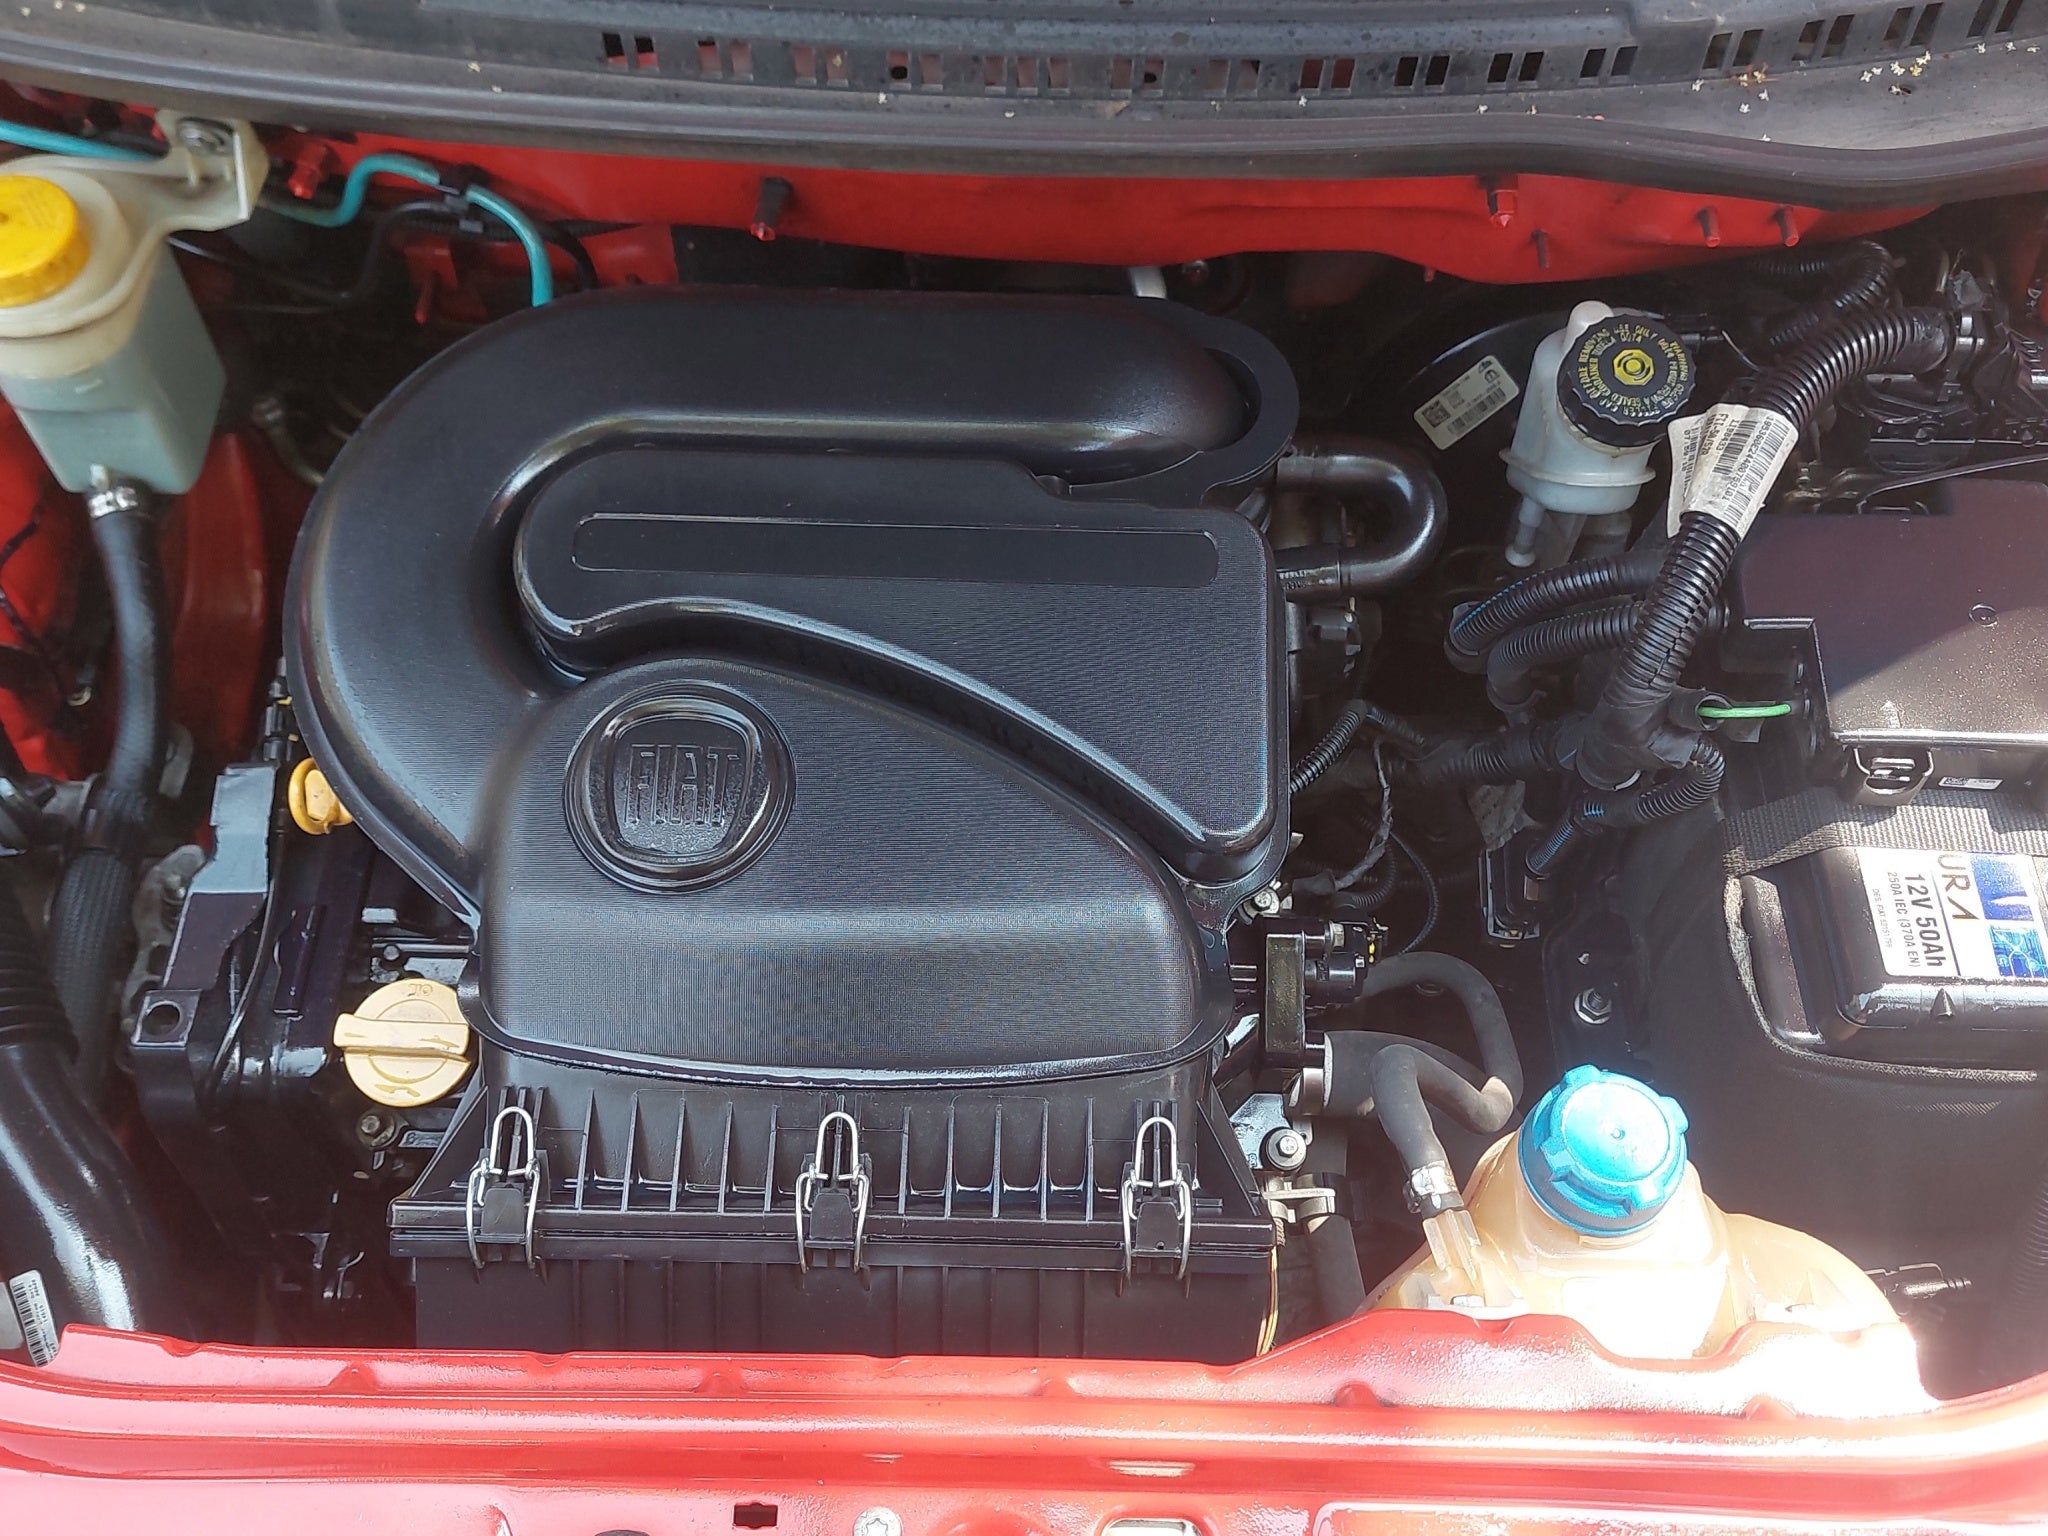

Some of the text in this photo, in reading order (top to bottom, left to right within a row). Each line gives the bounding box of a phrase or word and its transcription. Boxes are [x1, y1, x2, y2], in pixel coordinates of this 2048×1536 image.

[624, 744, 740, 826] FIAT
[1887, 871, 1921, 968] 250A IEC (370A EN)
[1905, 874, 1946, 967] 12V 50Ah
